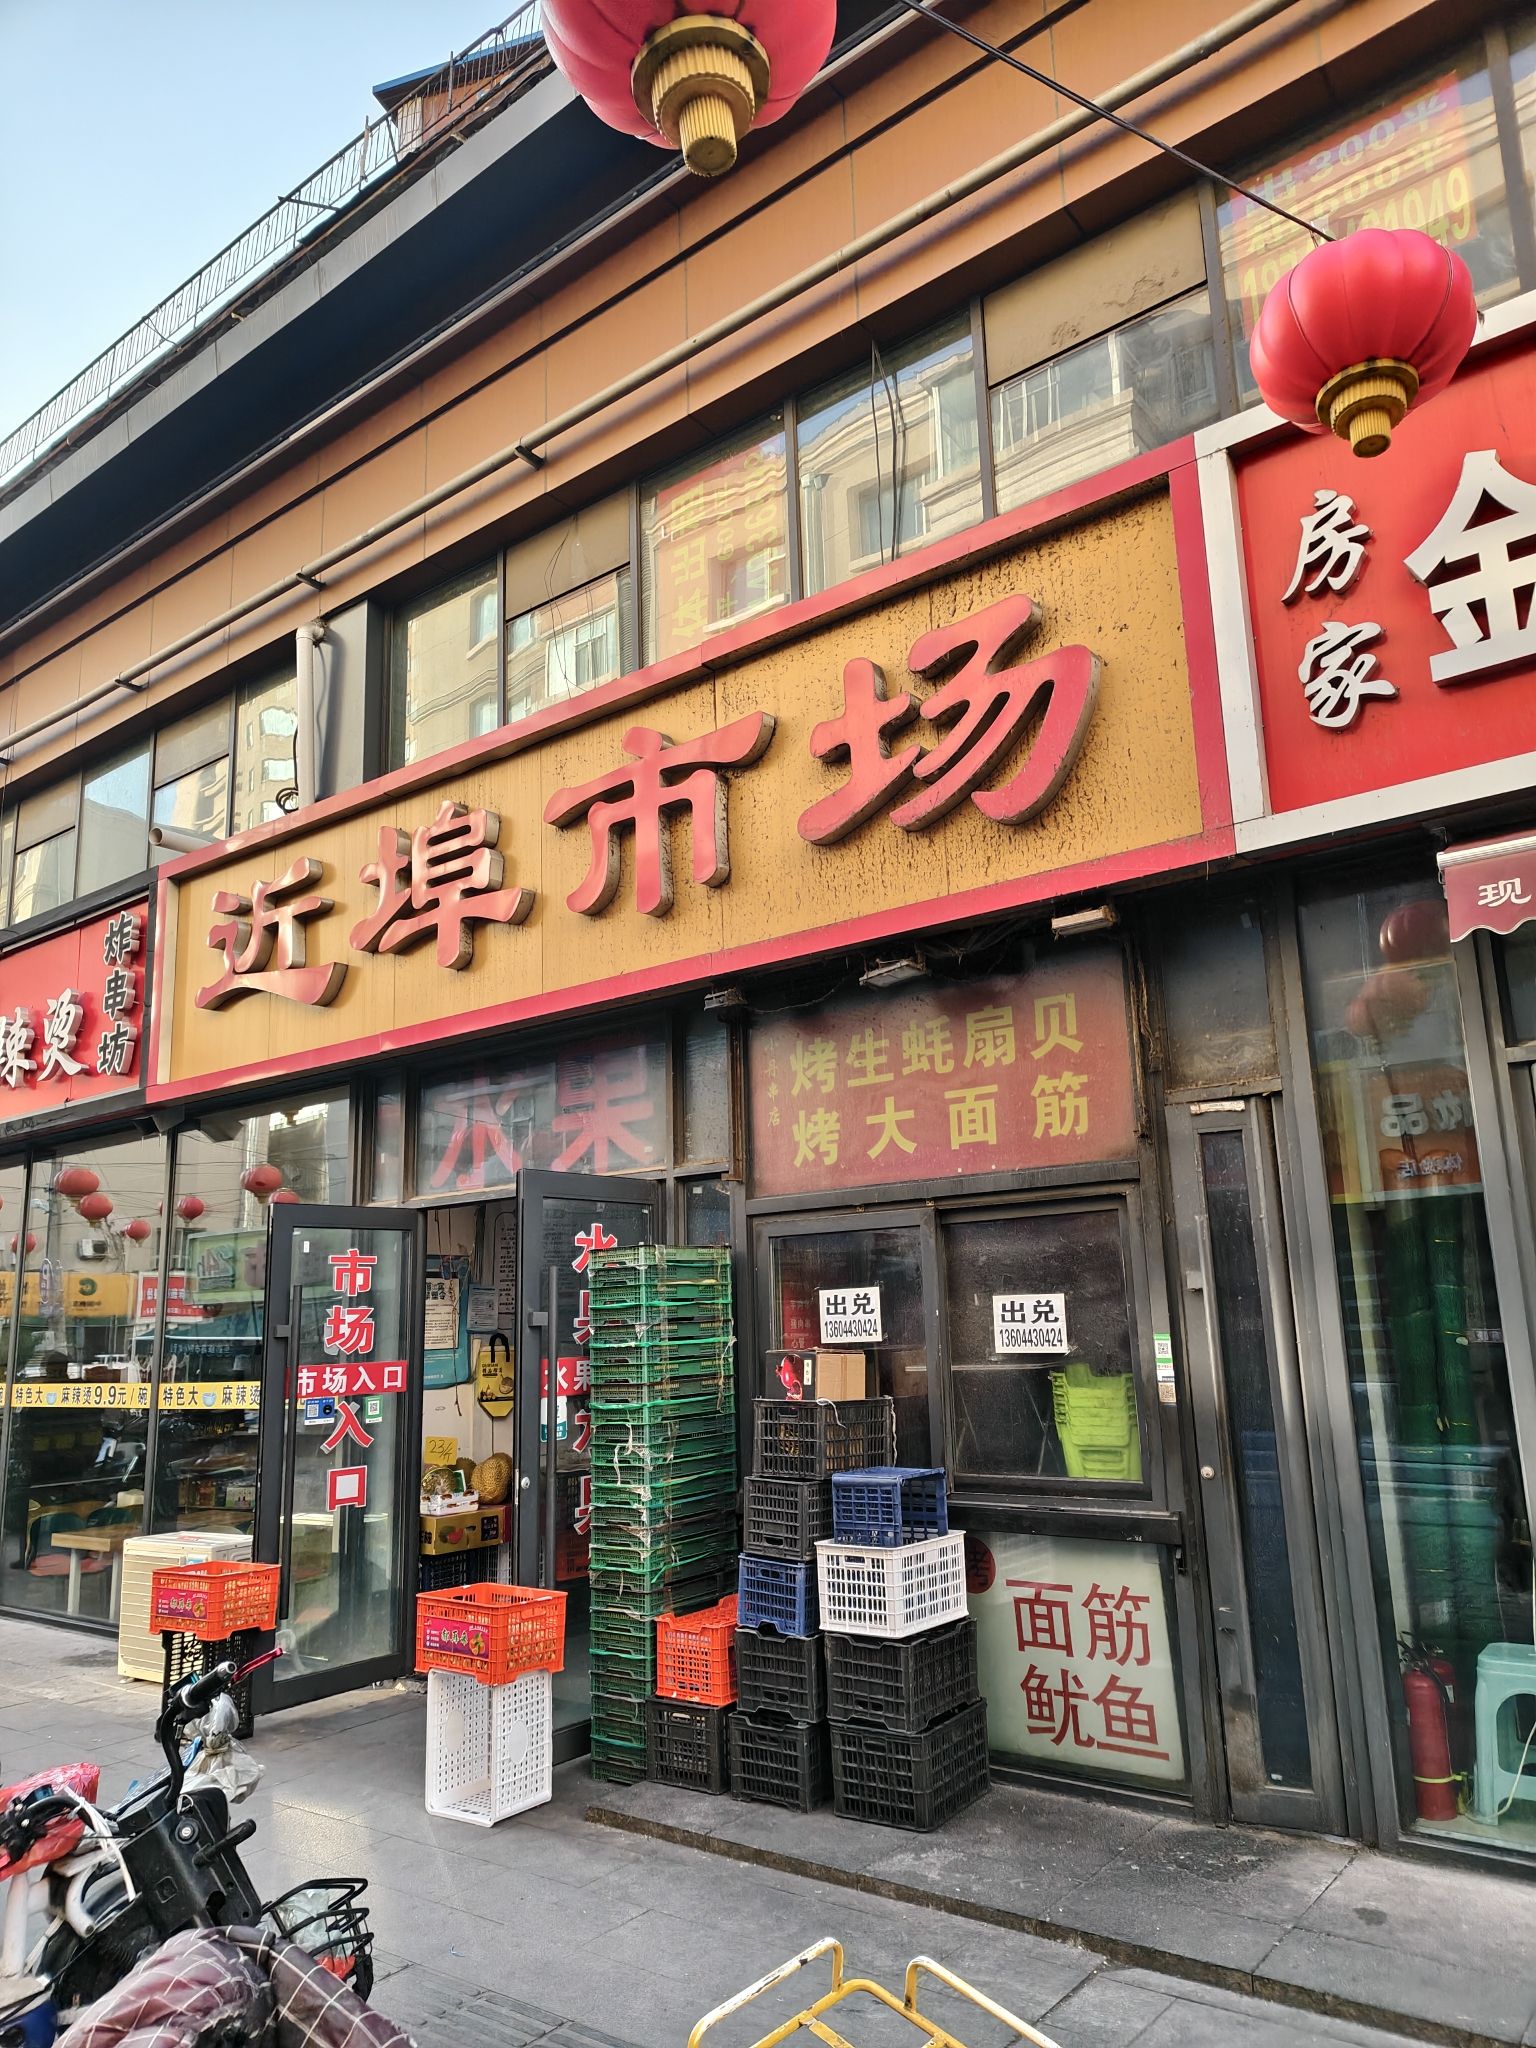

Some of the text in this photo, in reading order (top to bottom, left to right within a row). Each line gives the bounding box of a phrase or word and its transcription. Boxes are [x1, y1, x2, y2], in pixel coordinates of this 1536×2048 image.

[1404, 449, 1536, 684] 金
[194, 592, 1103, 1010] 近埠市场
[1477, 877, 1532, 908] 现
[97, 911, 140, 1076] 炸串坊
[789, 992, 1084, 1097] 烤生蚝扇贝
[430, 1044, 655, 1190] 水果
[792, 1071, 1090, 1168] 烤大面筋
[824, 1319, 879, 1338] 13604430424
[826, 1293, 876, 1316] 出兑
[1000, 1328, 1063, 1348] 13604430424
[1001, 1300, 1060, 1324] 出兑
[15, 1386, 43, 1405] 特色大
[163, 1386, 199, 1406] 特色大
[297, 1366, 403, 1396] 市场入口
[324, 1248, 378, 1512] 市场入口
[1005, 1579, 1151, 1667] 面筋
[1020, 1663, 1170, 1761] 鱿鱼
